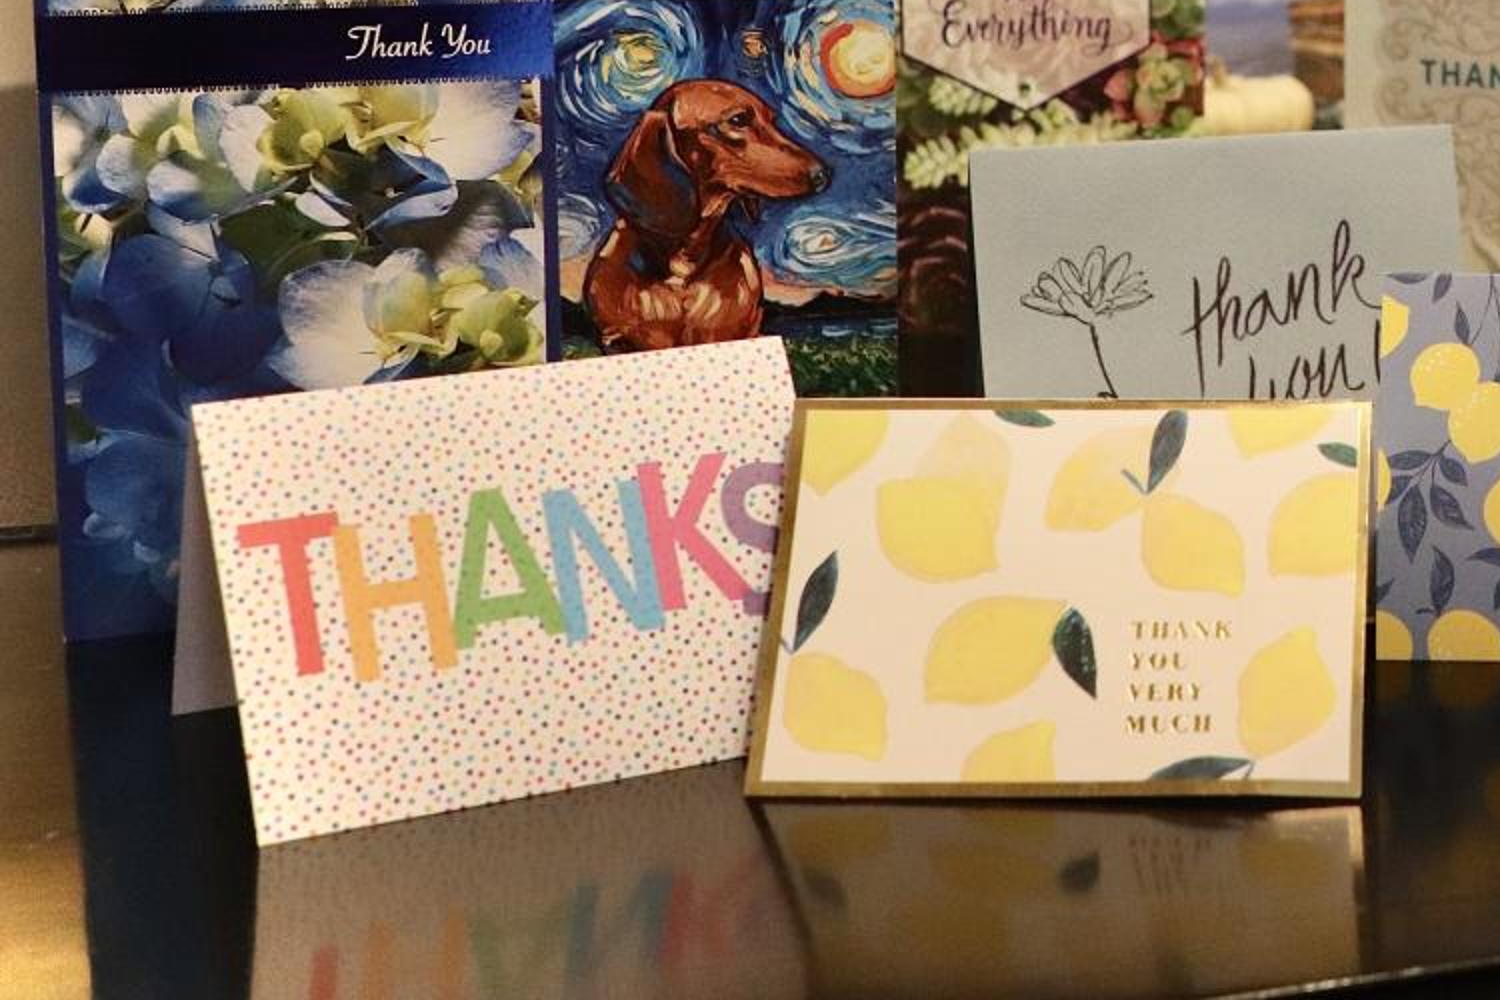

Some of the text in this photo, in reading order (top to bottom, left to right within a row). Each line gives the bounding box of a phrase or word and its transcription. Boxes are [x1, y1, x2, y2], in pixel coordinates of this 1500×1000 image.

[345, 21, 492, 60] Thank You
[1181, 219, 1383, 398] thank
[236, 451, 784, 683] THANKS
[1129, 619, 1232, 640] THANK
[1128, 682, 1201, 702] VERY
[1124, 713, 1212, 734] MUCH
